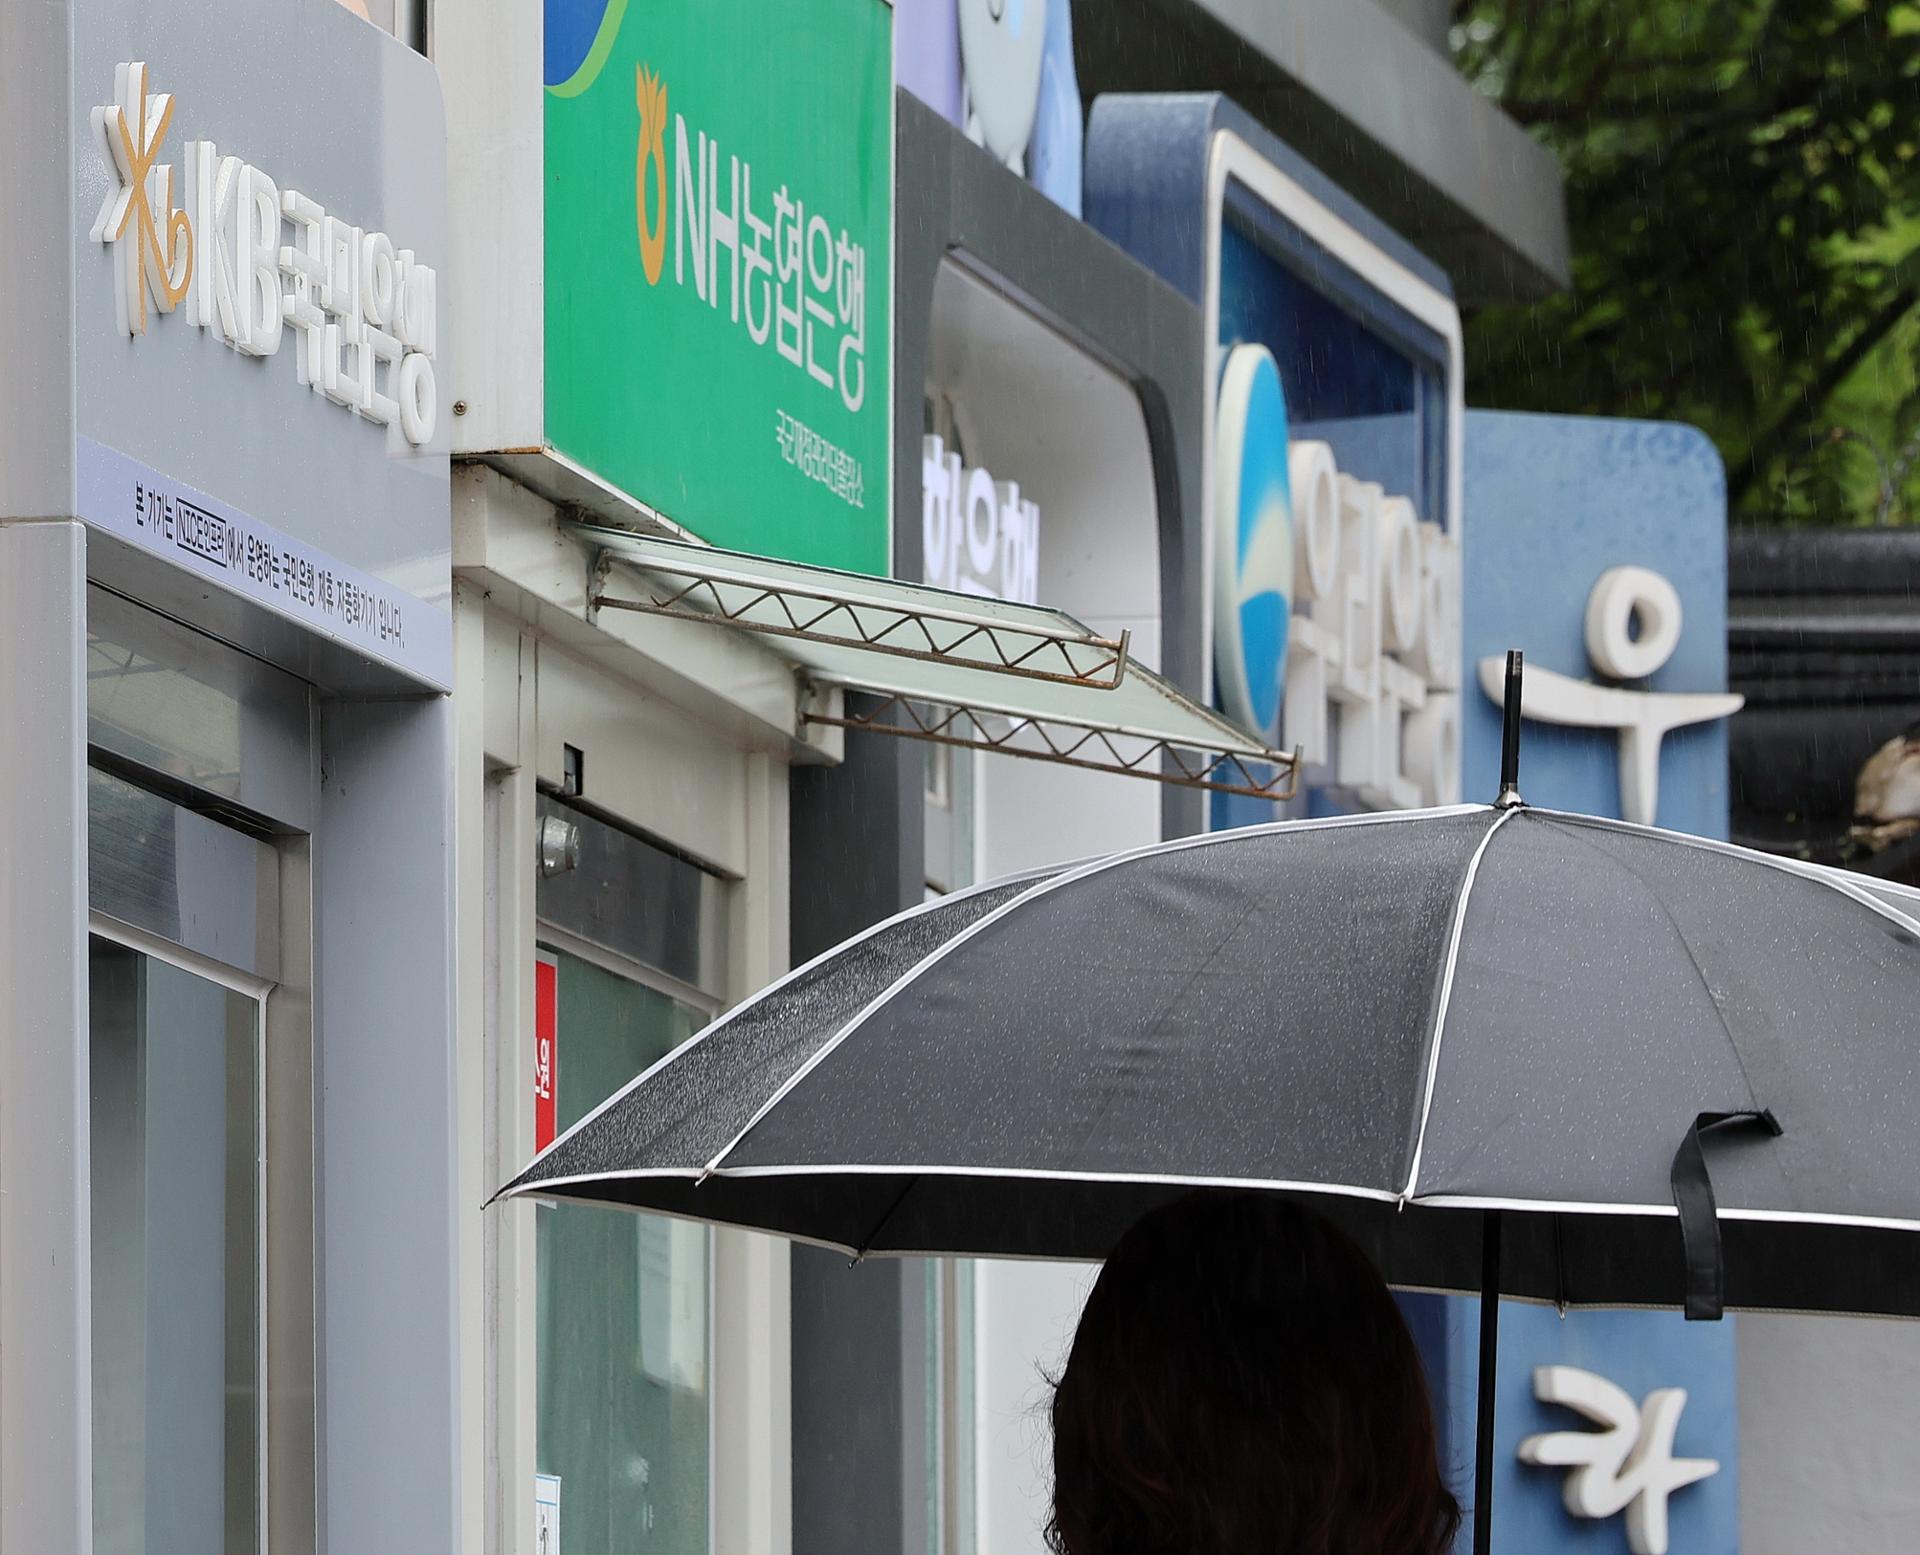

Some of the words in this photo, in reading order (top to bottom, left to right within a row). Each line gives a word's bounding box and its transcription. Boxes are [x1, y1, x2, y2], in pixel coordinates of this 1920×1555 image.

[185, 140, 437, 444] KB국민은행
[675, 113, 865, 412] NH농협은행
[135, 480, 144, 527] 본
[148, 490, 173, 540] 기기는
[247, 535, 280, 590] 운영하는
[283, 552, 315, 607] 국민은행
[318, 569, 334, 616] 제휴
[337, 579, 377, 637] 자동화기기
[1286, 440, 1463, 812] 우리은행
